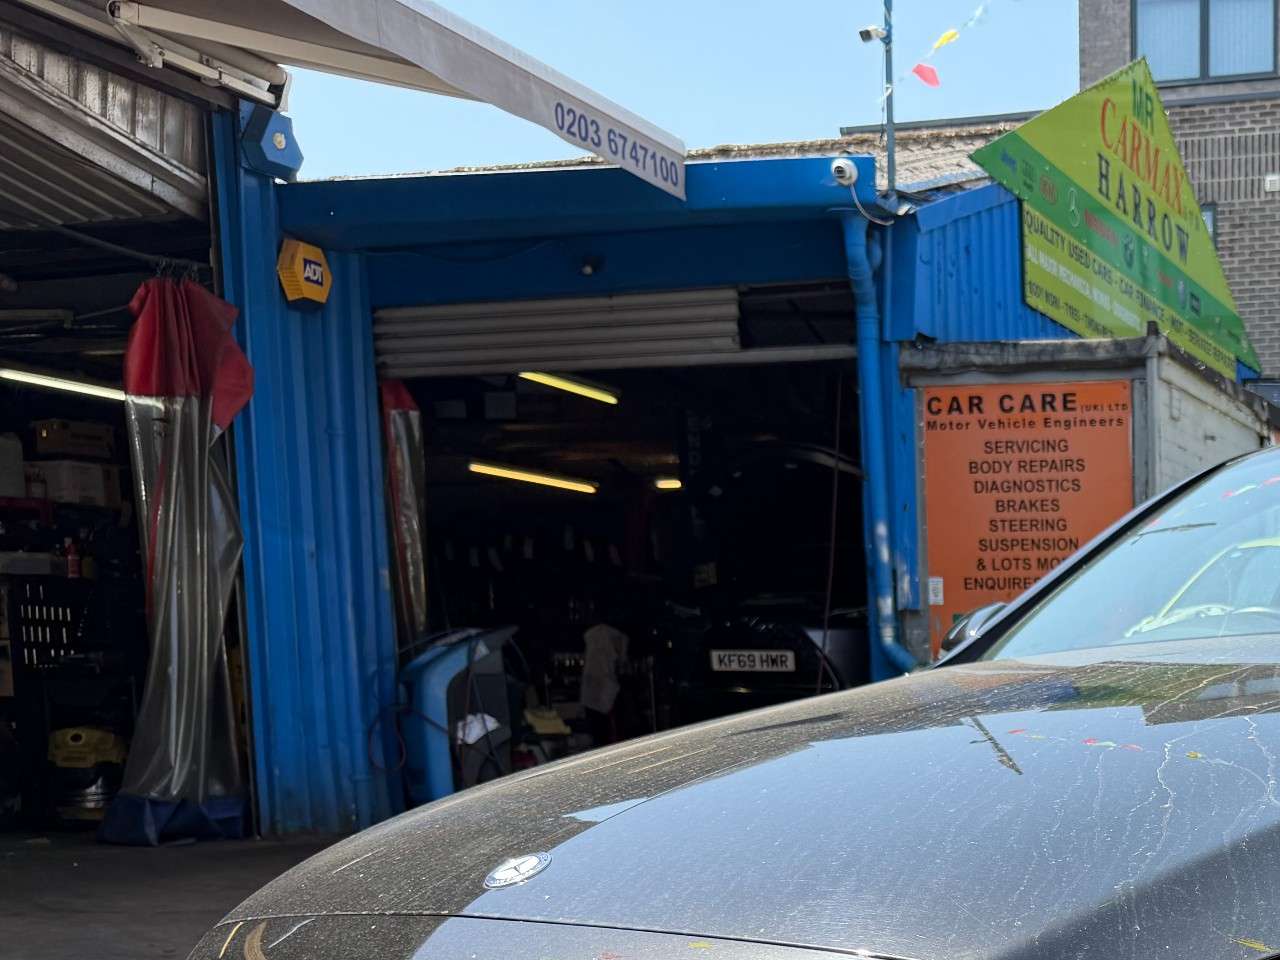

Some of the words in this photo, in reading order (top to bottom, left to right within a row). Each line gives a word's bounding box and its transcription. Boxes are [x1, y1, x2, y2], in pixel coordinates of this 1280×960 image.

[1132, 79, 1154, 136] MR
[555, 102, 602, 147] 0203
[608, 128, 679, 187] 6747100
[1101, 97, 1185, 216] CARMAX
[1097, 153, 1190, 265] HARROW
[303, 262, 323, 283] ADT
[927, 396, 984, 415] CAR
[999, 392, 1077, 414] CARE
[1108, 403, 1129, 412] LTD
[927, 420, 971, 432] Motor
[978, 418, 1037, 430] Vehicle
[1043, 417, 1124, 431] Engineers
[984, 439, 1069, 455] SERVICING
[968, 461, 1012, 475] BODY
[1018, 459, 1086, 474] REPAIRS
[973, 478, 1081, 494] DIAGNOSTICS
[995, 499, 1060, 513] BRAKES
[989, 519, 1067, 533] STEERING
[978, 538, 1079, 552] SUSPENSION
[976, 558, 987, 572] &
[992, 557, 1032, 571] LOTS
[1037, 557, 1066, 570] MO
[759, 653, 789, 668] HWR
